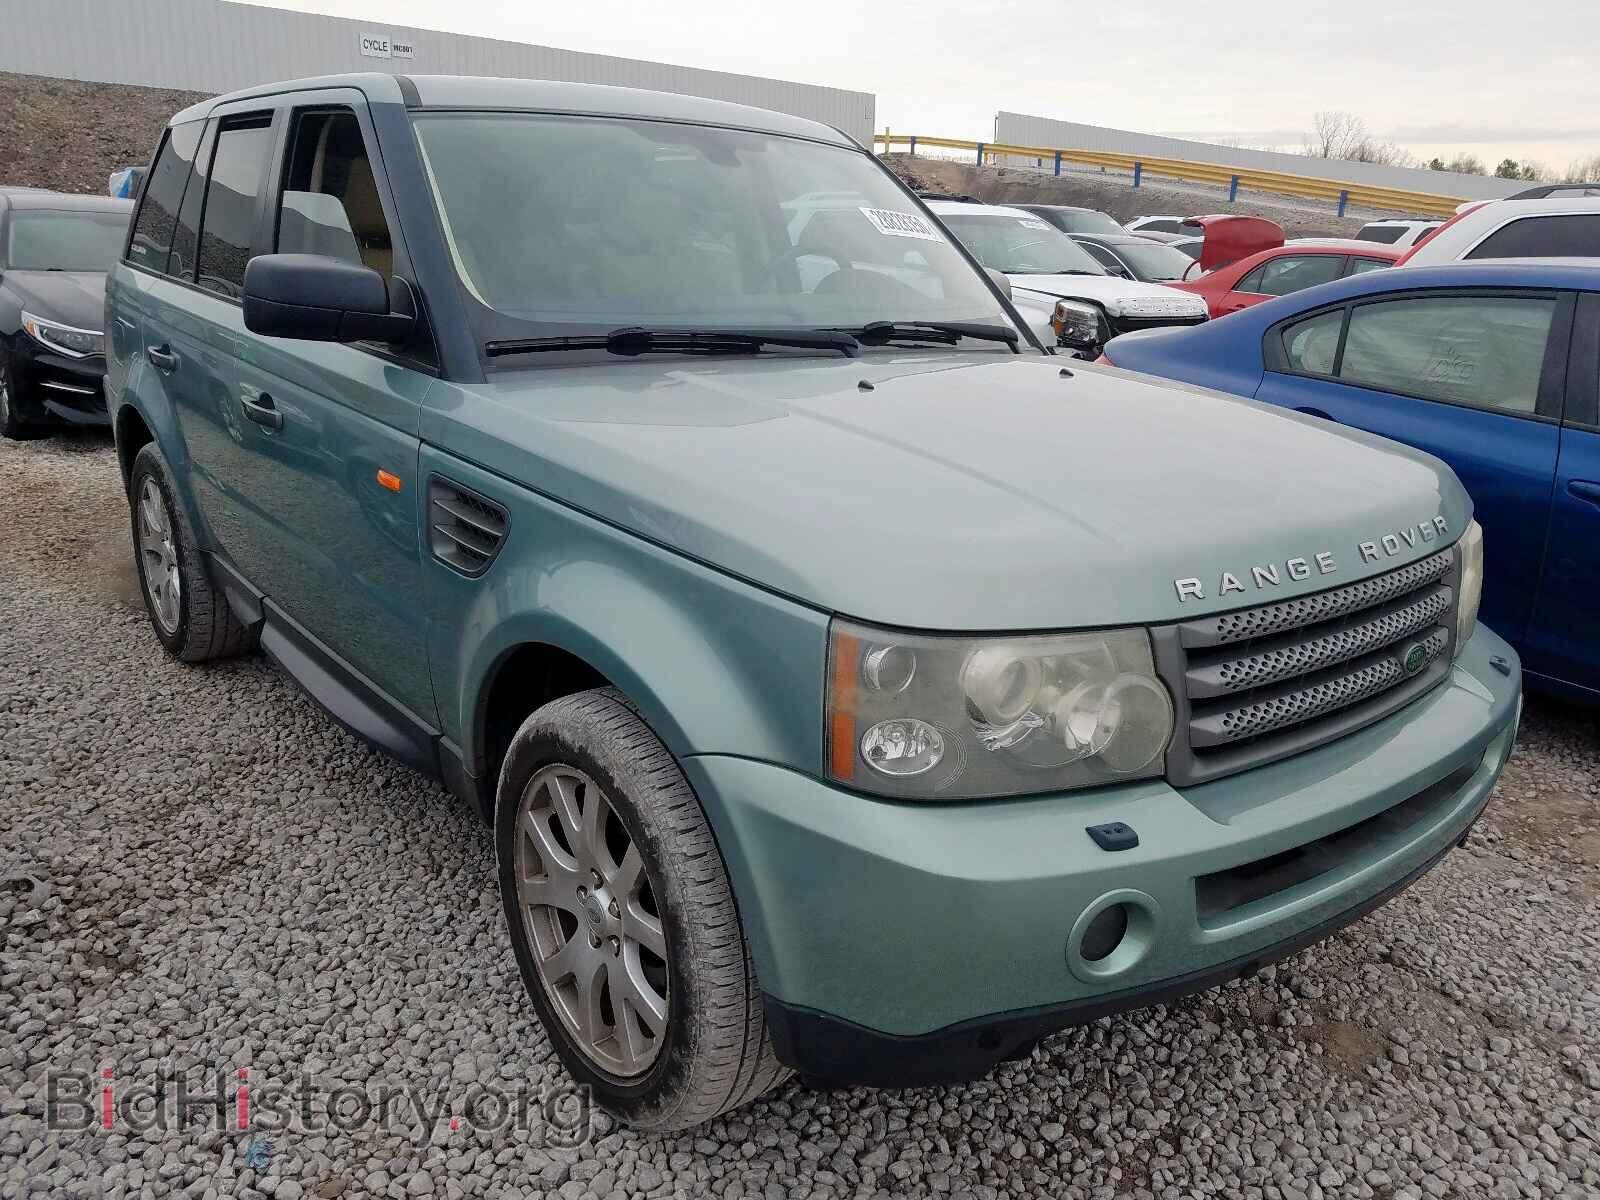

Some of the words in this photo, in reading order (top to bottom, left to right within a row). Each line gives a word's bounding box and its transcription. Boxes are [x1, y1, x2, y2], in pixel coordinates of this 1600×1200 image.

[363, 38, 389, 52] CYCLE
[1174, 551, 1337, 602] RANGE
[1357, 515, 1449, 563] ROVER
